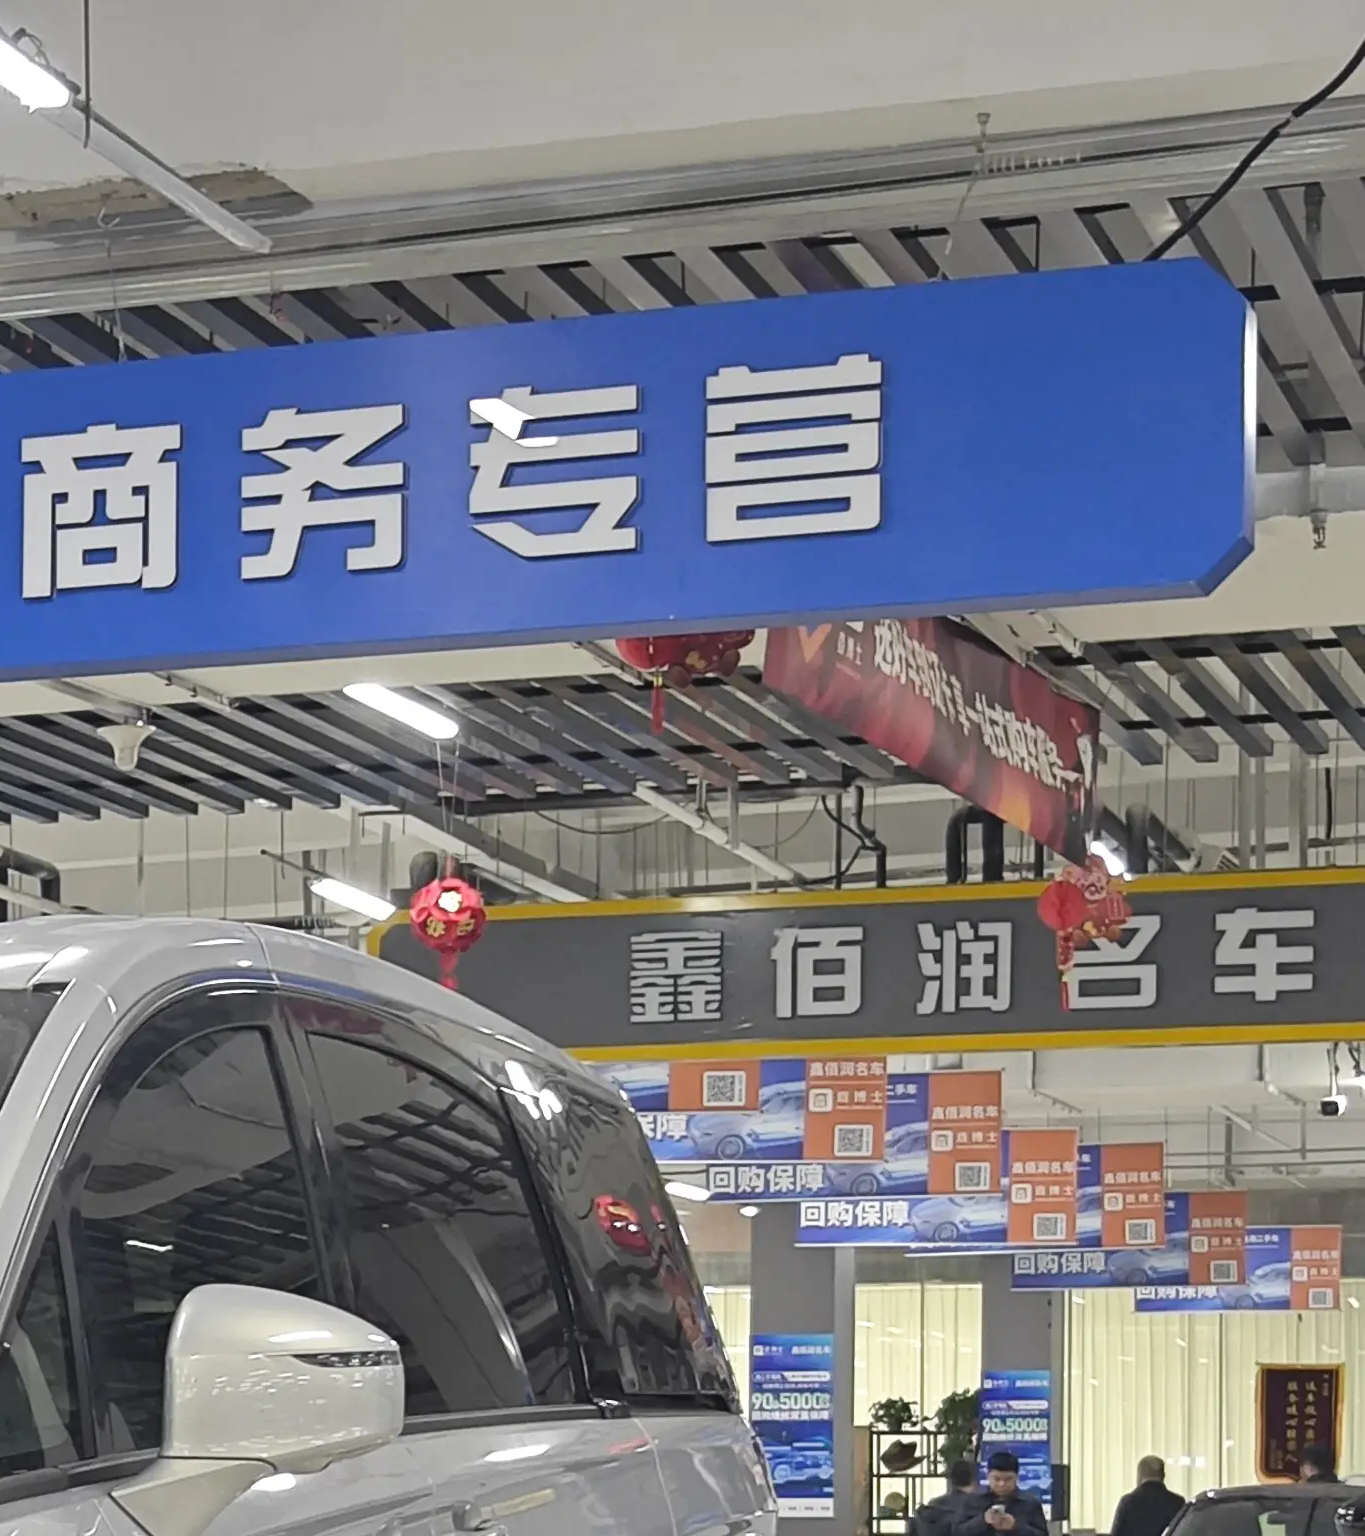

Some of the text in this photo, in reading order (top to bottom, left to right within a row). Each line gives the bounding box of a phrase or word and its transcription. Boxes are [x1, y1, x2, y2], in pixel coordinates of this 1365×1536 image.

[19, 352, 883, 600] 商务专营
[629, 907, 1316, 1026] 鑫佰润名车
[709, 1164, 825, 1195] 回购保障
[800, 1200, 912, 1228] 回购保障
[1014, 1251, 1106, 1275] 回购保障
